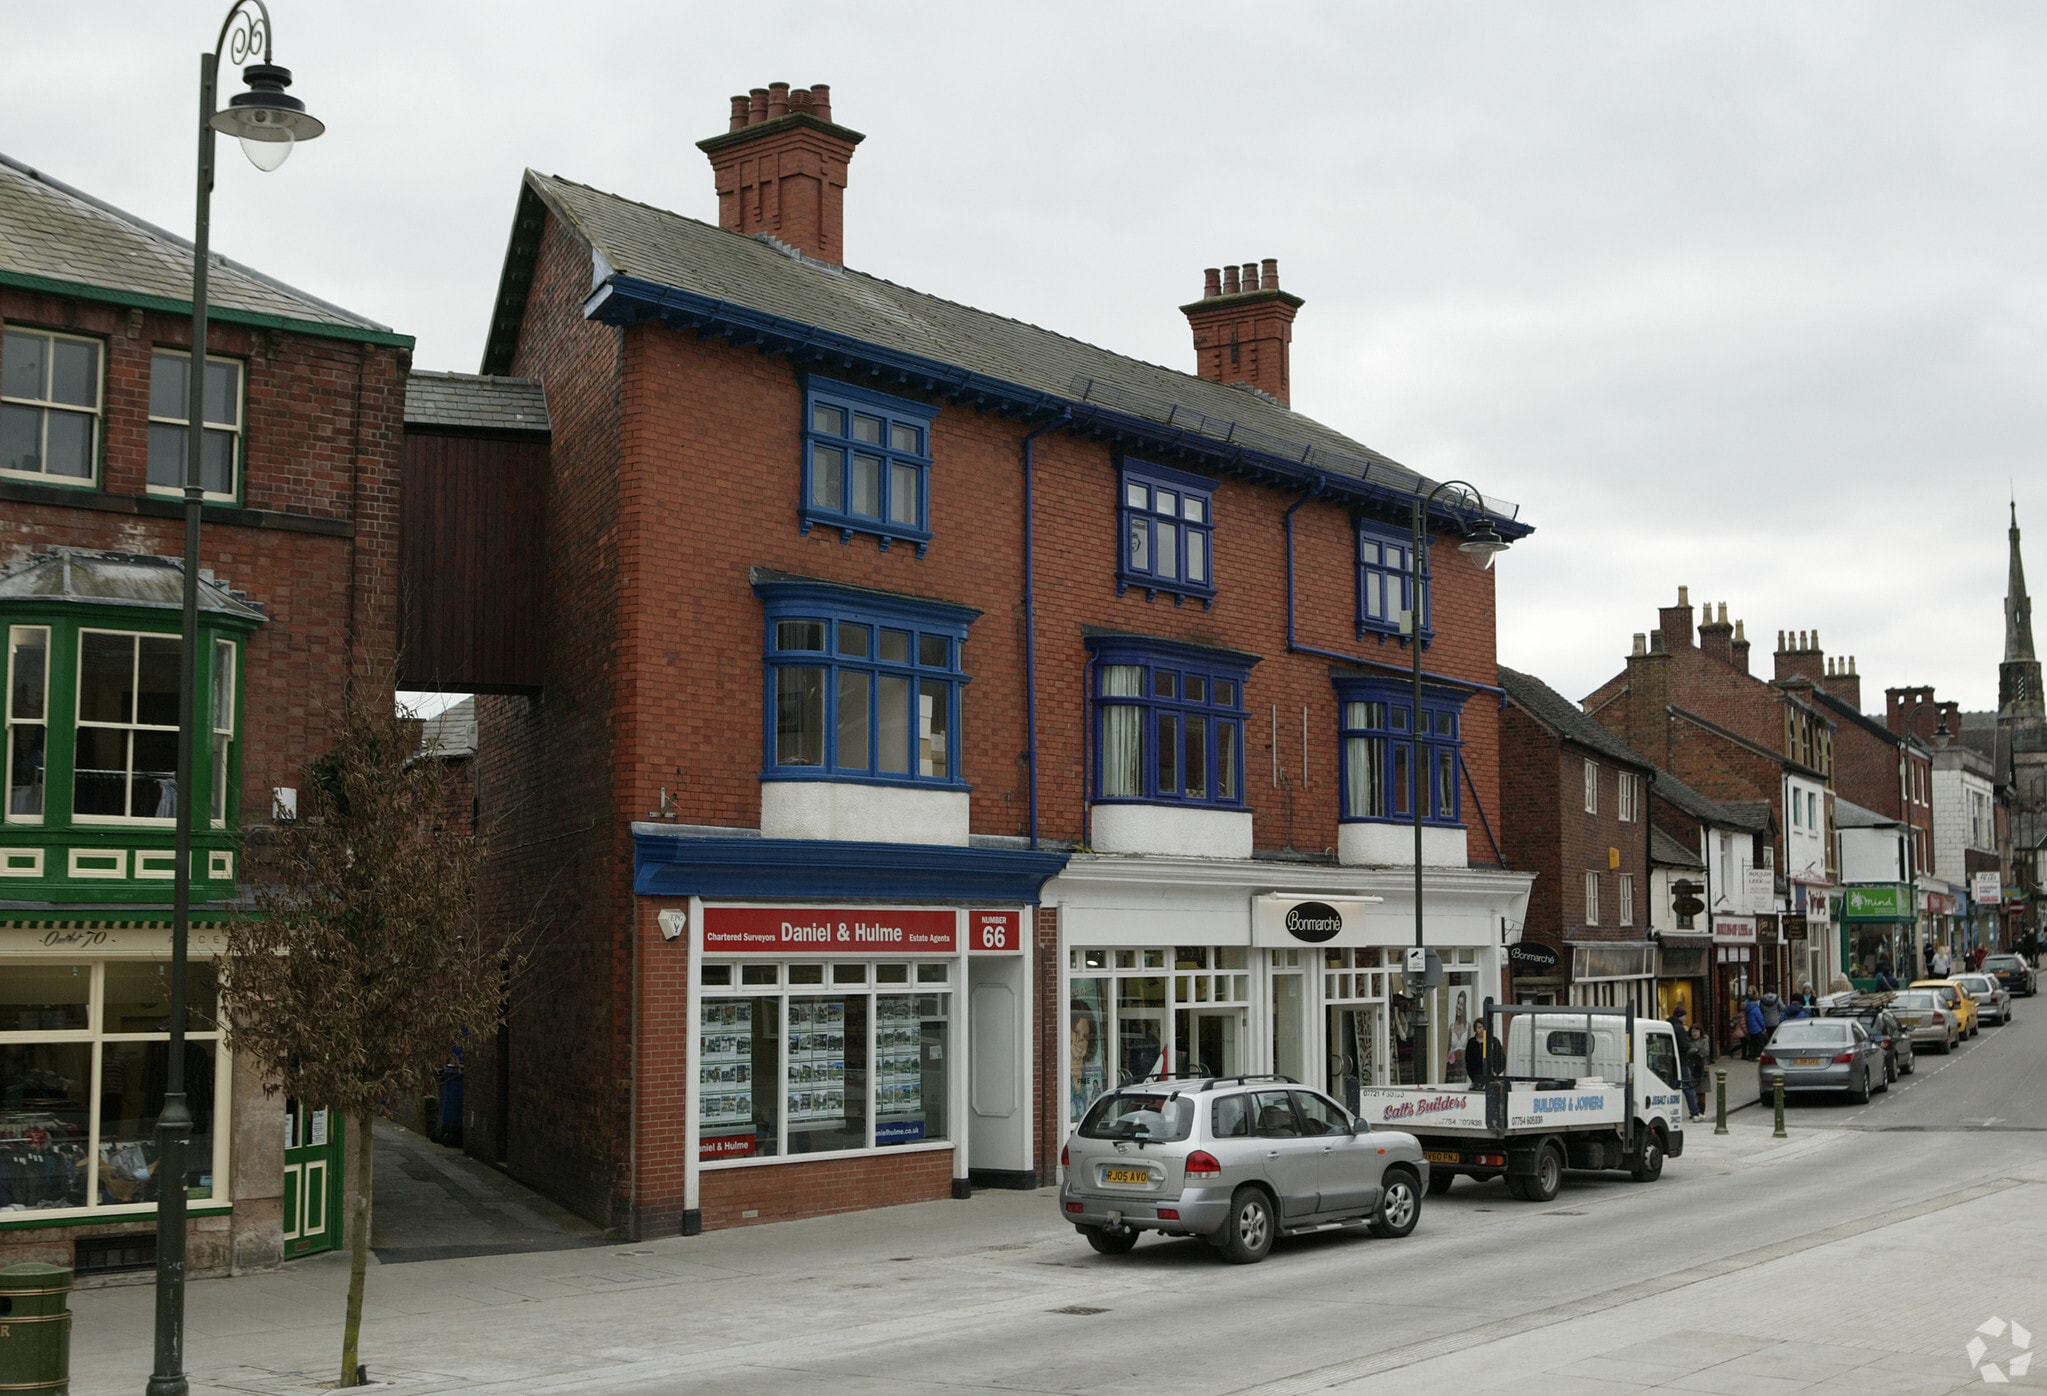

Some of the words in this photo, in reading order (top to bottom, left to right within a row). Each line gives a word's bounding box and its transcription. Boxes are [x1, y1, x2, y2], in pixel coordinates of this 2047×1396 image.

[981, 916, 1007, 924] NUMBER
[1287, 910, 1341, 931] Bonmarché
[81, 931, 107, 948] 70
[707, 932, 742, 941] Chartered
[743, 933, 776, 942] Surveyors
[781, 922, 831, 942] Daniel
[836, 922, 850, 942] &
[855, 922, 903, 942] Hulme
[909, 933, 928, 942] Estate
[928, 933, 950, 943] Agents
[982, 926, 1006, 947] 66
[1511, 947, 1555, 965] Bonmarché
[1383, 1102, 1415, 1121] Salt's
[1416, 1095, 1467, 1117] Builders
[1533, 1097, 1566, 1113] BUILDERS
[1568, 1097, 1573, 1111] &
[1574, 1095, 1604, 1111] JOINERS
[1511, 1116, 1526, 1126] 07754
[717, 1142, 723, 1151] &
[724, 1141, 749, 1150] Hulme
[1443, 1152, 1458, 1162] FNJ
[1107, 1171, 1128, 1181] RJ05
